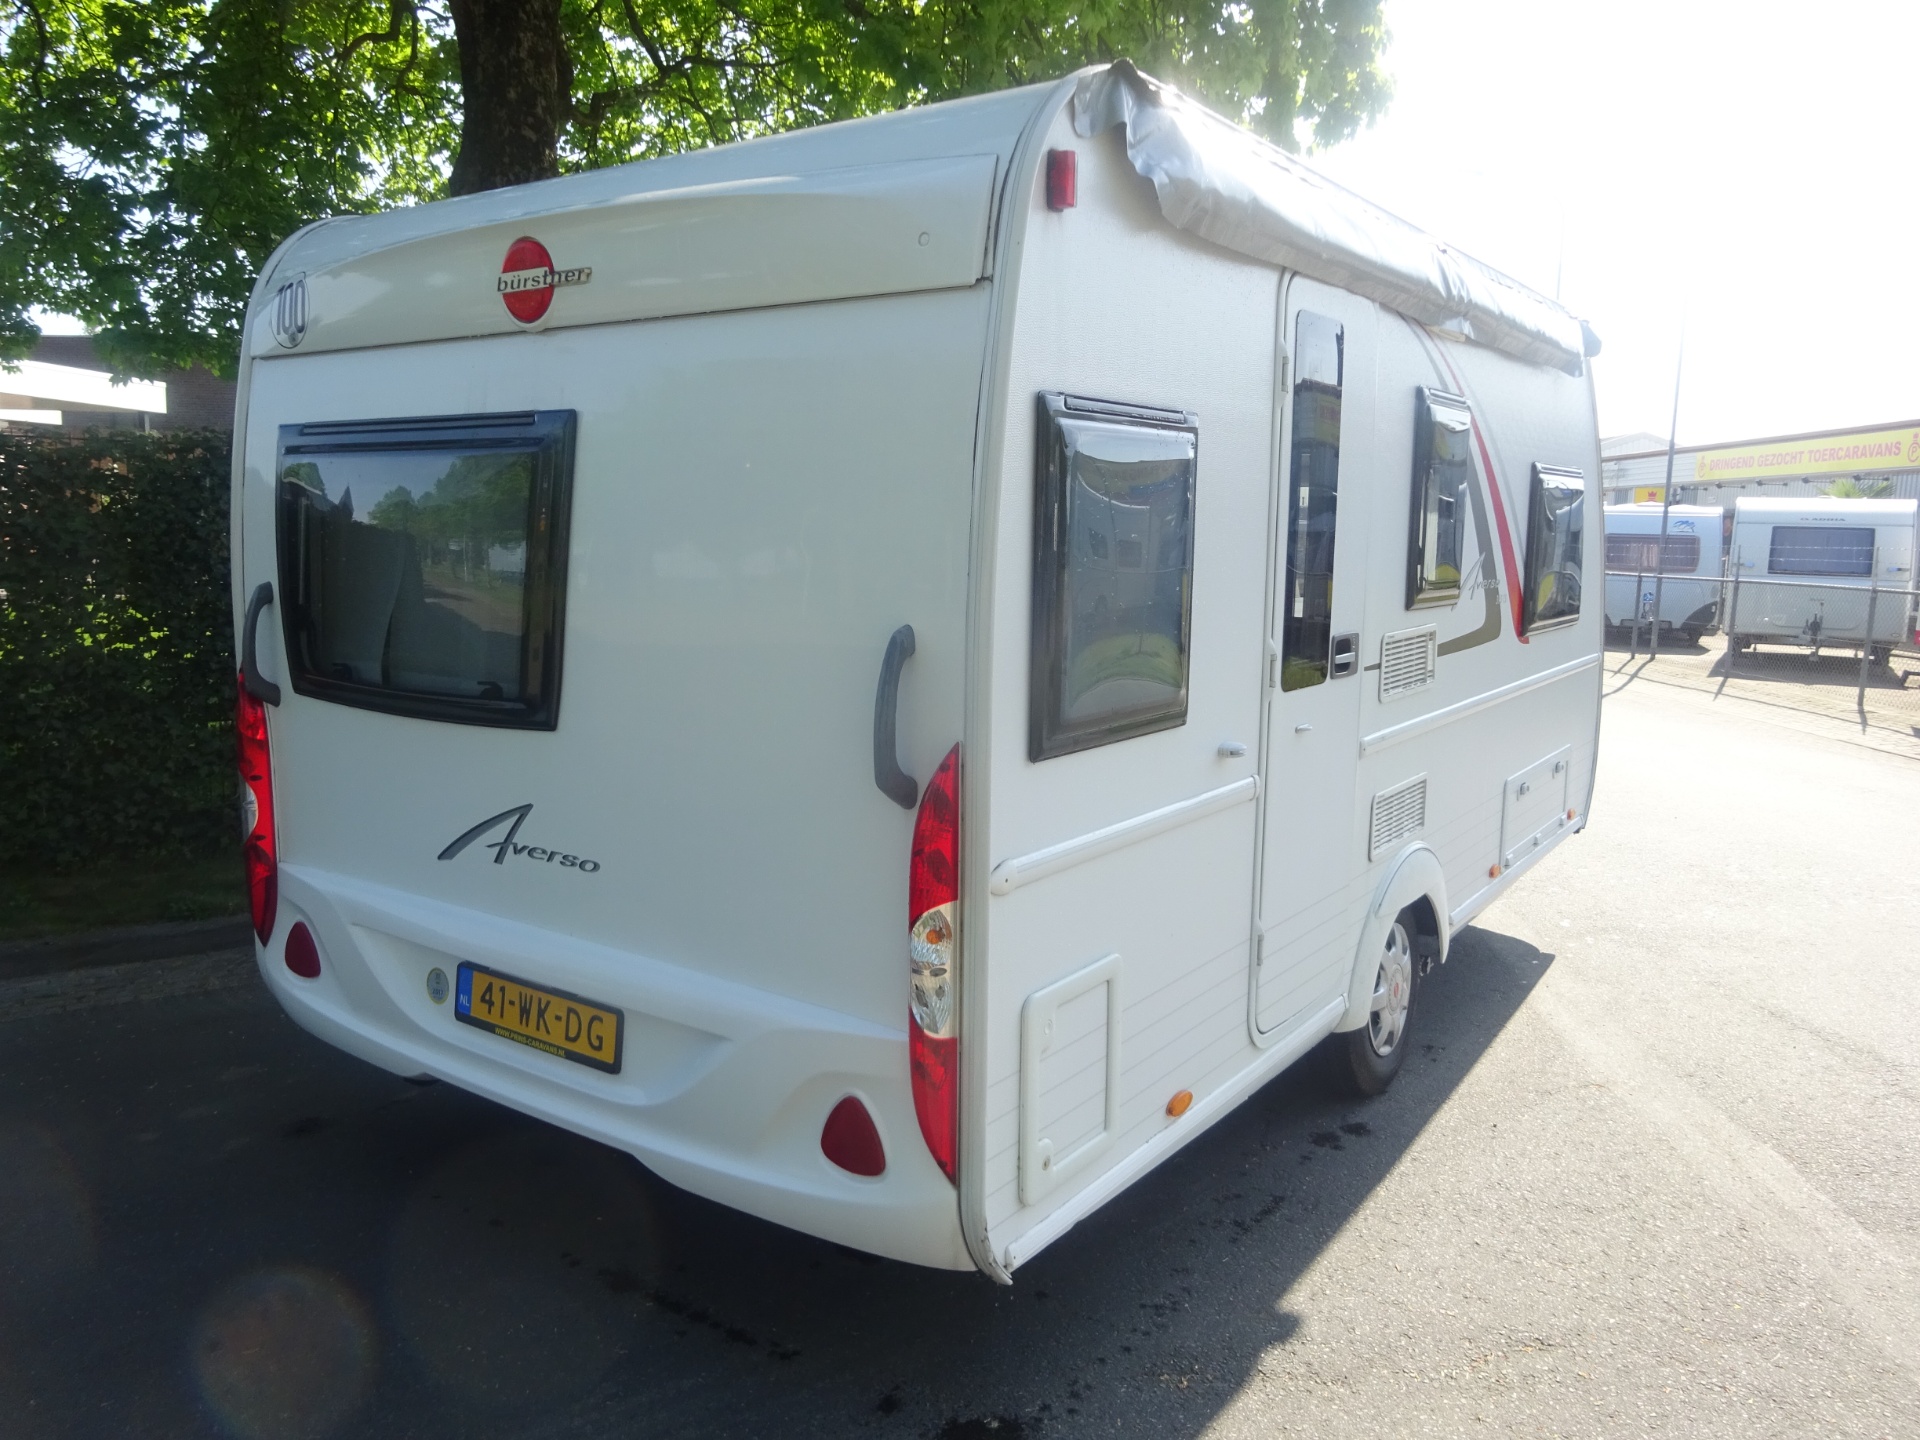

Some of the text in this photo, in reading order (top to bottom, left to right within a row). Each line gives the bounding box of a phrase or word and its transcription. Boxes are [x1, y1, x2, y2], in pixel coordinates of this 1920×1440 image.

[497, 269, 588, 292] bürstner
[276, 280, 306, 336] 100
[1709, 441, 1902, 471] DRINGEND GEZOCHT TOERCARAVANS
[437, 803, 601, 873] Averso
[459, 993, 470, 1007] NL
[480, 981, 604, 1052] 41-WK-DG
